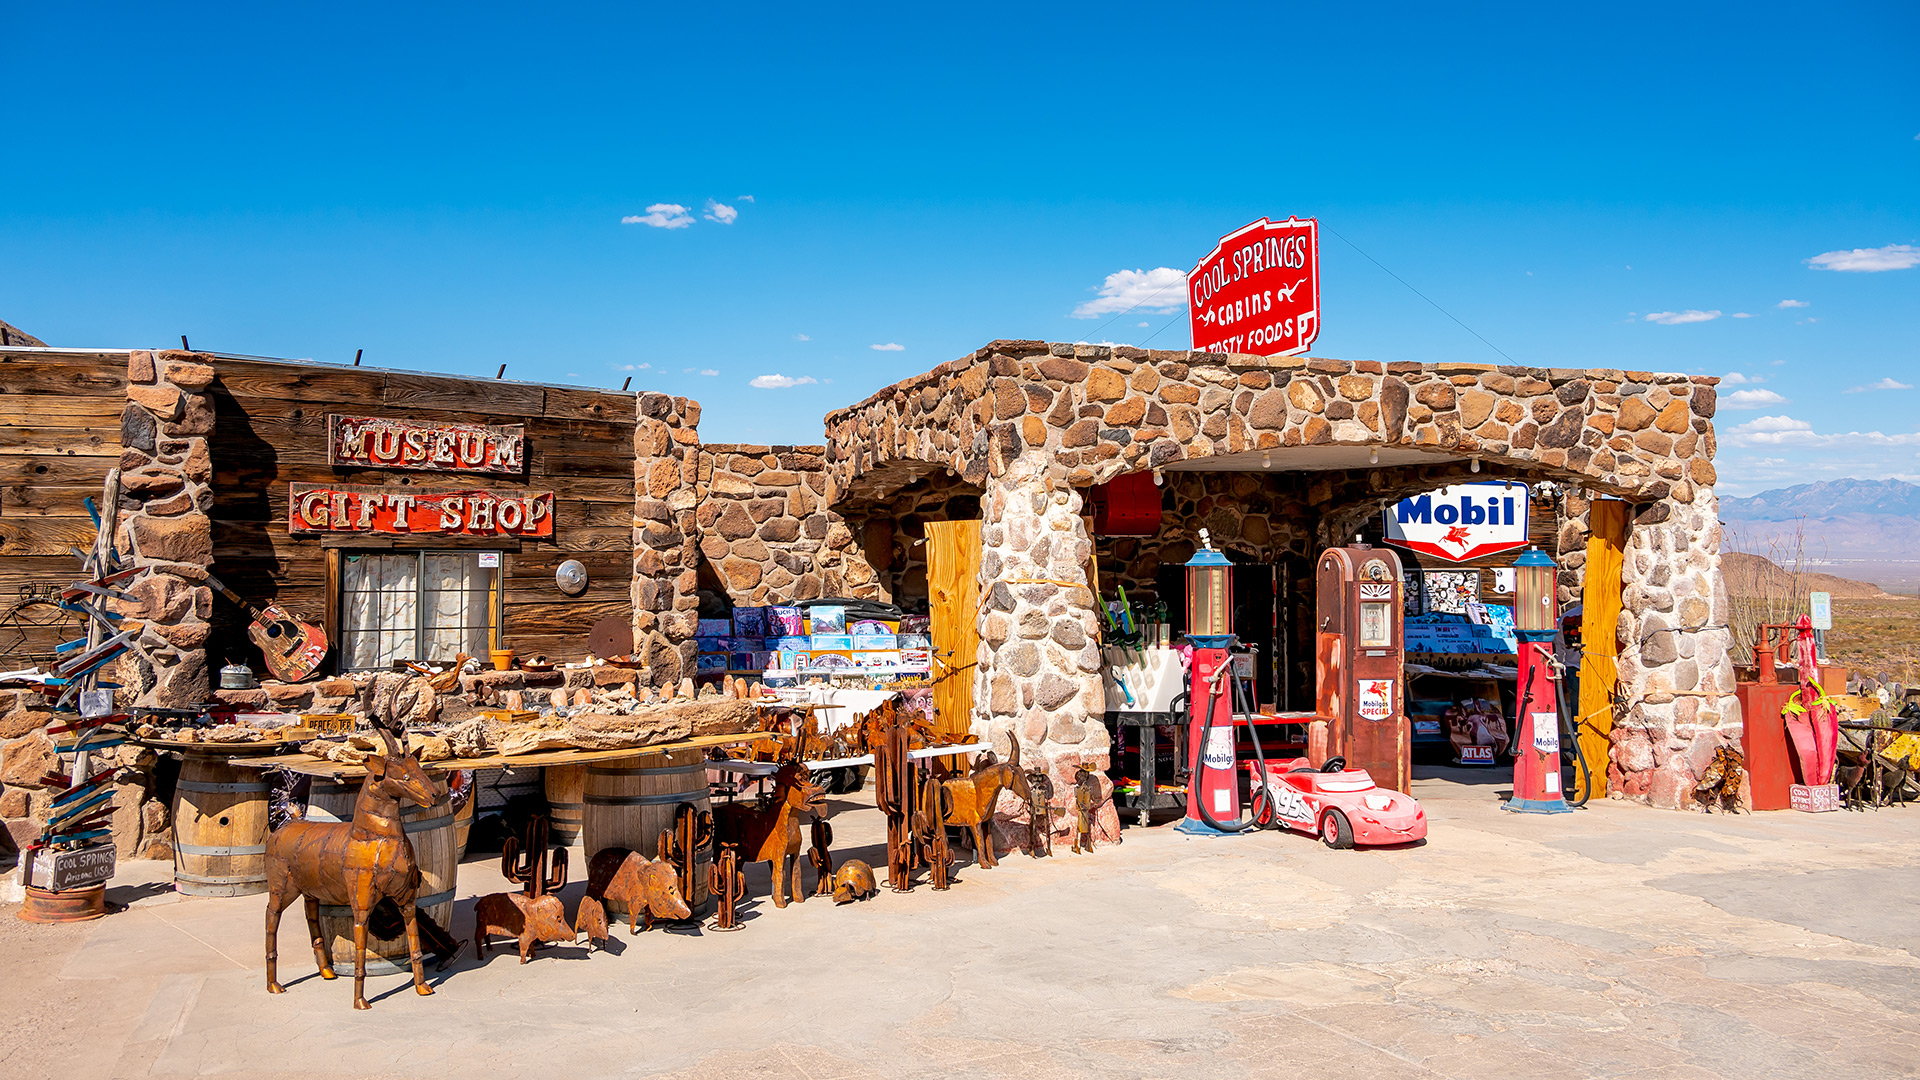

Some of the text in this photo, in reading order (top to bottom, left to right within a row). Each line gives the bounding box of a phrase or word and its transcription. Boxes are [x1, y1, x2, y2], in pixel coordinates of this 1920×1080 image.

[1194, 234, 1307, 308] COOL SPRINGS
[1218, 290, 1272, 326] CABINS
[1247, 318, 1293, 350] FOODS
[340, 424, 520, 467] MUSEUM
[300, 491, 545, 531] GIFT SHOP
[1397, 495, 1514, 525] Mobil
[1361, 707, 1390, 716] SPECIAL
[1362, 700, 1388, 708] Mobilgas
[1462, 747, 1492, 758] ATLAS
[1278, 791, 1303, 819] 95
[58, 857, 77, 871] COOL
[80, 850, 114, 867] SPRINGS
